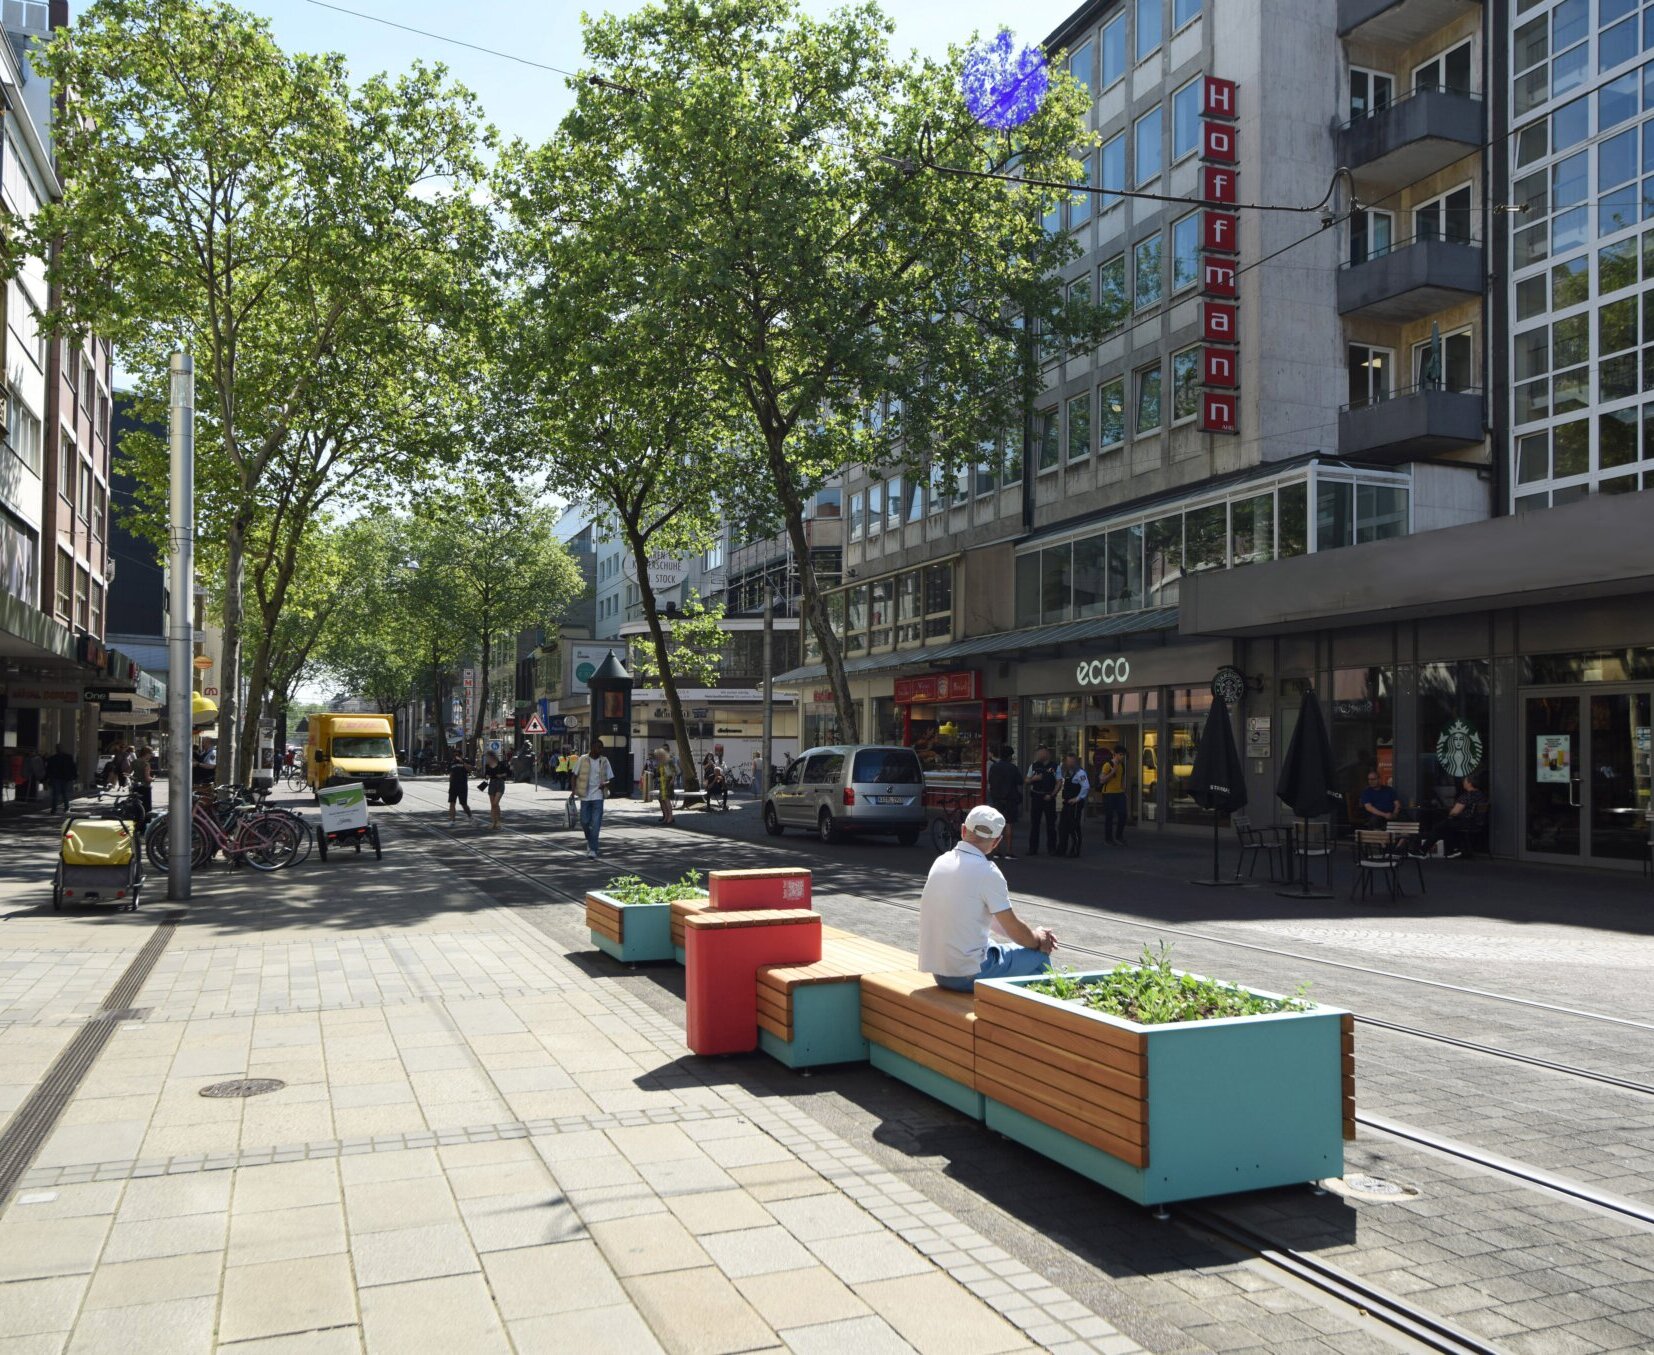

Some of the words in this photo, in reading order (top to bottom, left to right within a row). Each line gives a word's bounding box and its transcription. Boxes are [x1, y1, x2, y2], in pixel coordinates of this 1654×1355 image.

[1205, 83, 1235, 423] Hoffmann
[632, 560, 681, 571] KERSCHUHE
[655, 574, 676, 584] STOCK
[1076, 657, 1130, 686] ecco
